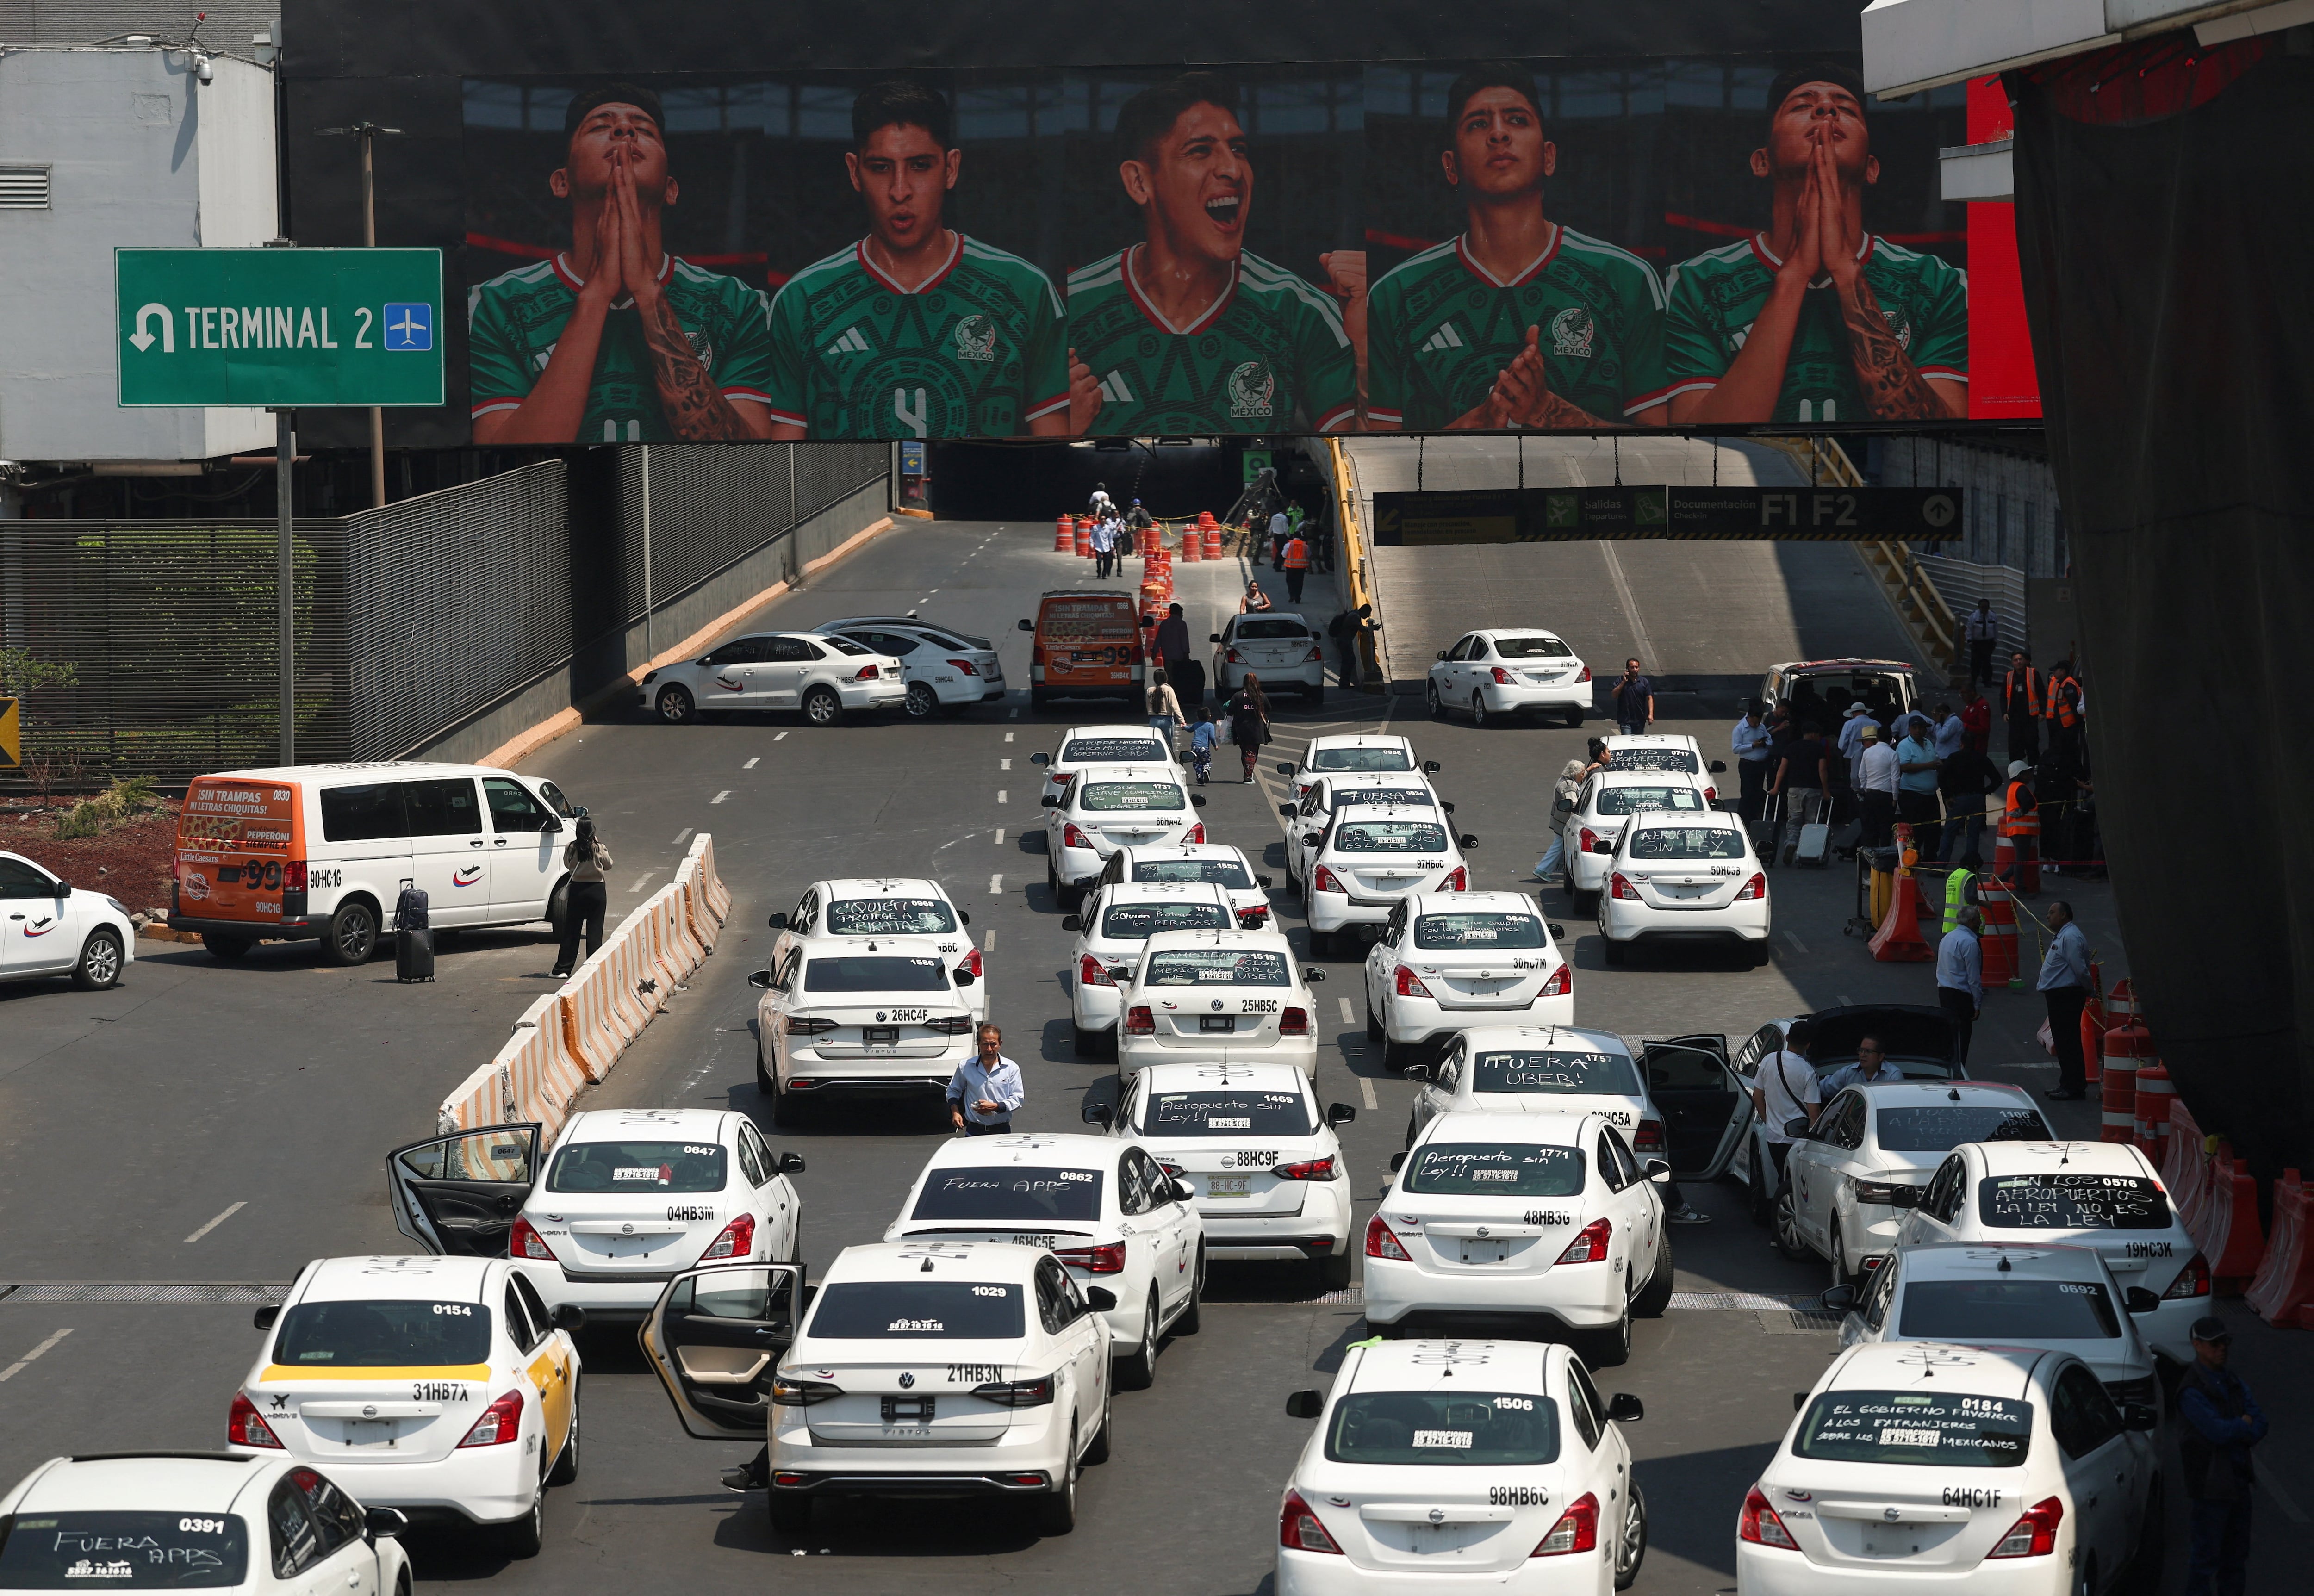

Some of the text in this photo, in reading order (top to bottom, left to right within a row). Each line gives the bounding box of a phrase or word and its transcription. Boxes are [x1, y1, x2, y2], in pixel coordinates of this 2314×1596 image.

[185, 307, 373, 349] TERMINAL 2
[958, 350, 993, 360] MÉXICO
[1555, 345, 1591, 357] MÉXICO
[894, 388, 927, 439] 4
[1231, 405, 1272, 417] MÉXICO
[1585, 499, 1622, 509] Salidas
[1673, 499, 1756, 509] Documentación
[1761, 494, 1858, 526] F1 F2
[1585, 512, 1627, 522] Departures
[197, 789, 261, 803] ¡SIN TRAMPAS
[273, 789, 290, 801] 0830
[1349, 792, 1406, 801] FUERA
[190, 802, 267, 815] NI LETRAS CHIQUITAS!
[247, 830, 290, 841] PEPPERONI
[245, 840, 280, 850] SIEMPRE
[1641, 840, 1723, 857] SIN LEY
[180, 851, 218, 863] Little Caesars
[241, 859, 282, 891] $99
[310, 869, 342, 888] 90-HC-1G
[255, 901, 281, 914] 90HC1G
[836, 913, 896, 923] PROTEGE
[1109, 911, 1151, 921] ¿Quién
[1423, 933, 1463, 942] legales?
[1238, 972, 1279, 981] UBER
[1242, 999, 1278, 1013] 25HB5C
[892, 1008, 928, 1022] 26HC4F
[1484, 1056, 1589, 1071] ¡FUERA
[1585, 1054, 1612, 1063] 1757
[1506, 1072, 1584, 1087] UBER!
[1160, 1098, 1248, 1112] Aeropuerto
[1263, 1095, 1294, 1104] 1469
[1158, 1111, 1208, 1124] Ley!!
[1999, 1111, 2030, 1119] 1100
[683, 1145, 716, 1156] 0647
[1539, 1148, 1569, 1159] 1771
[1237, 1151, 1279, 1167] 88HC9F
[1424, 1150, 1549, 1165] Aeropuerto sin
[1059, 1171, 1093, 1183] 0862
[1420, 1165, 1468, 1180] Ley!!
[943, 1177, 1071, 1192] FUERA APPS
[1210, 1180, 1247, 1191] 88-HC-9F
[2012, 1176, 2041, 1187] EN
[2053, 1175, 2098, 1186] LOS
[2102, 1178, 2138, 1189] 0576
[1995, 1188, 2153, 1202] AEROPUERTOS
[667, 1205, 714, 1221] 04HB3M
[1996, 1203, 2148, 1215] LA LEY NO ES
[1523, 1210, 1570, 1226] 48HB3G
[2020, 1214, 2116, 1227] LA LEY
[1011, 1235, 1056, 1250] 46HC5E
[2125, 1242, 2173, 1258] 19HC3K
[971, 1286, 1007, 1298] 1029
[2059, 1284, 2098, 1296] 0692
[432, 1304, 472, 1317] 0154
[947, 1363, 1003, 1383] 21HB3N
[413, 1383, 468, 1402] 31HB7X
[1493, 1397, 1534, 1411] 1506
[1833, 1404, 1945, 1416] EL GOBIERNO
[1961, 1397, 2003, 1413] 0184
[1824, 1418, 1976, 1430] A LOS EXTRANJEROS
[1414, 1430, 1473, 1438] RESERVACIONES
[1881, 1428, 1941, 1436] RESERVACIONES
[1413, 1436, 1424, 1445] 55
[1426, 1436, 1472, 1446] 5716-1616
[1879, 1435, 1940, 1444] 55 5716-1616
[1943, 1437, 2018, 1450] MEXICANOS
[1489, 1486, 1549, 1506] 98HB6C
[1943, 1486, 2001, 1509] 64HC1F
[179, 1518, 225, 1534] 0391
[54, 1531, 158, 1552] FUERA
[148, 1548, 223, 1566] APPS
